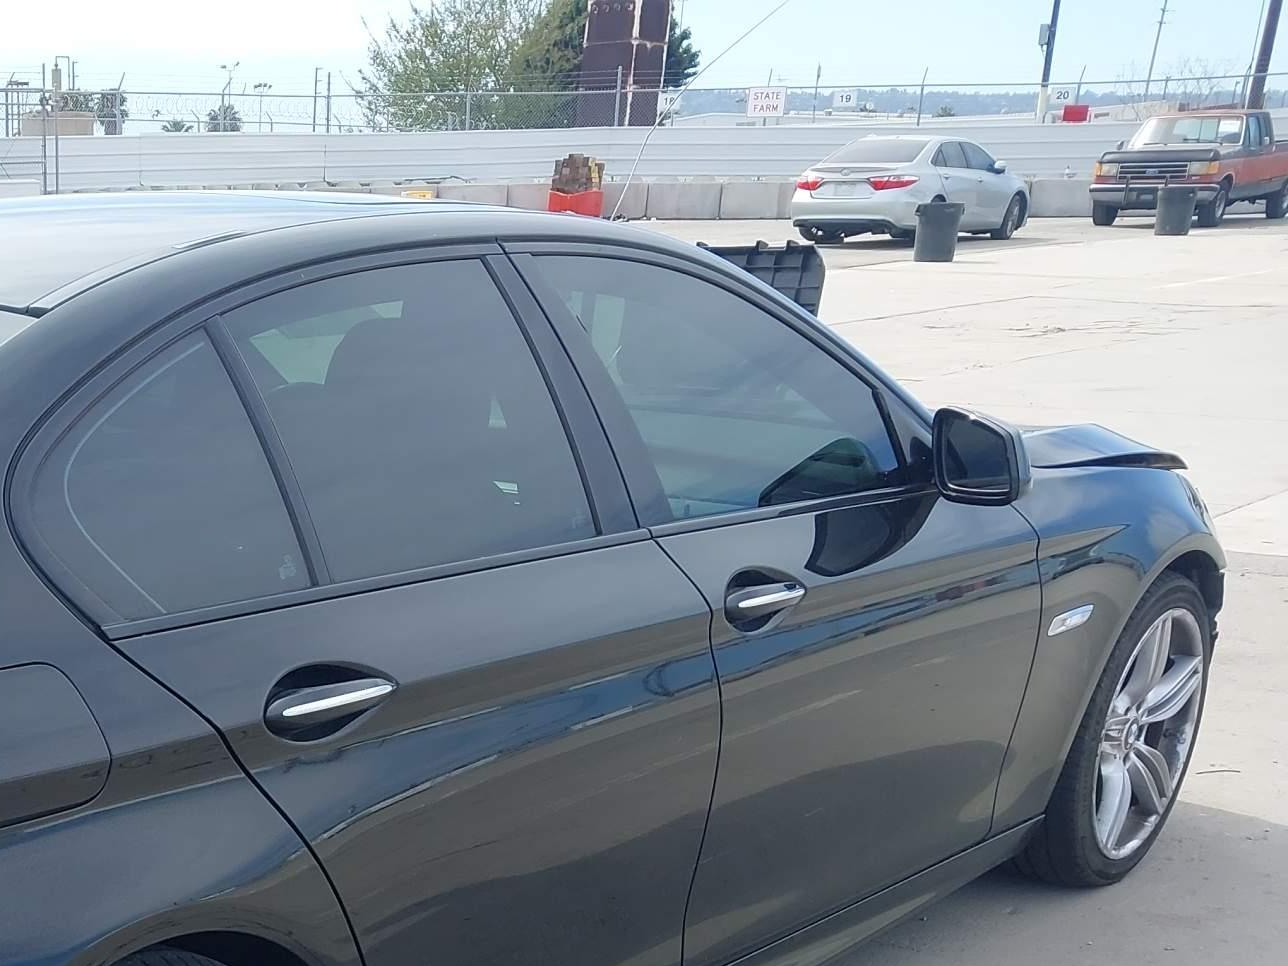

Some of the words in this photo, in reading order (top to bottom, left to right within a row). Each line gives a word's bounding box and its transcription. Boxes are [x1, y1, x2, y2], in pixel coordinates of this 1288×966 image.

[753, 91, 781, 101] STATE
[840, 94, 852, 103] 19
[1056, 90, 1070, 99] 20
[753, 103, 779, 112] FARM
